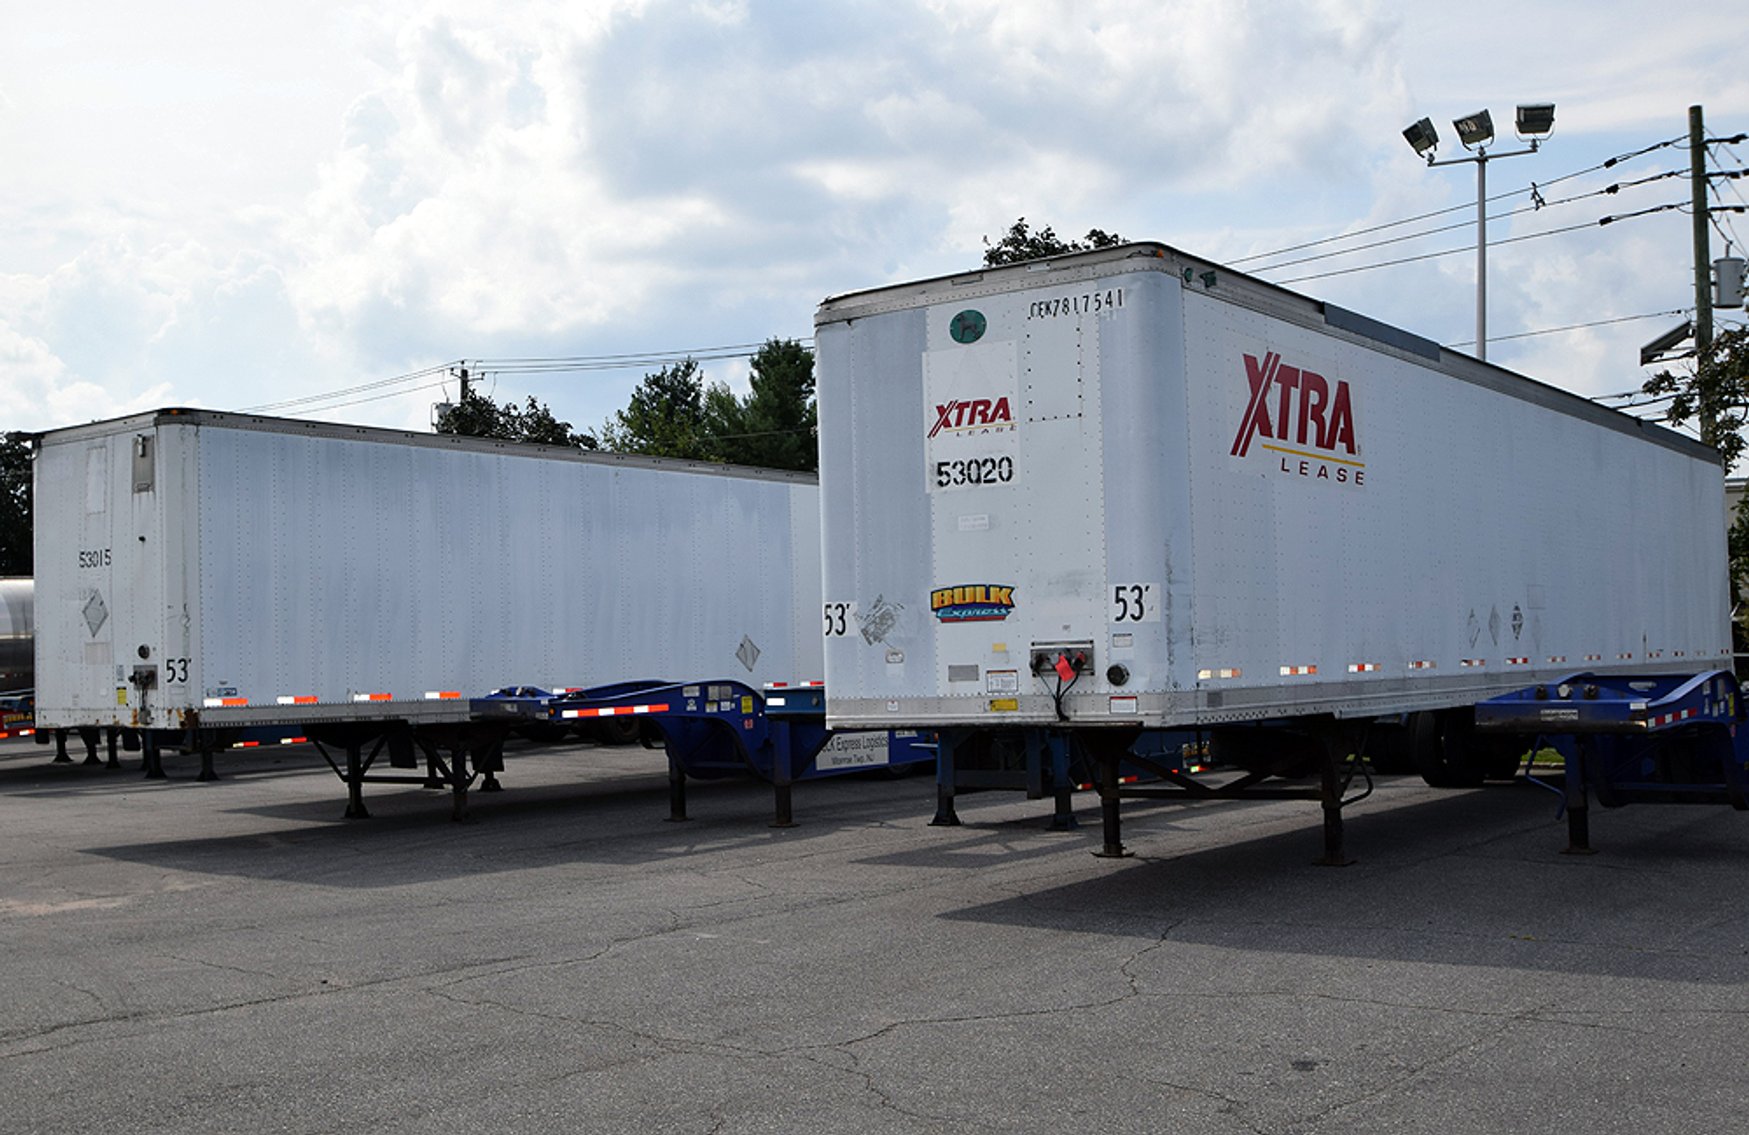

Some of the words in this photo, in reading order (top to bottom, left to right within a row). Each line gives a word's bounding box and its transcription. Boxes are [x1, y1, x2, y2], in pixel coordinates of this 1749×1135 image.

[927, 397, 1012, 439] XTRA
[1230, 351, 1357, 458] XTRA
[937, 456, 1013, 487] 53020
[1280, 457, 1366, 486] LEASE
[79, 549, 111, 568] 53015
[931, 585, 1015, 611] BULK
[836, 736, 861, 753] Express
